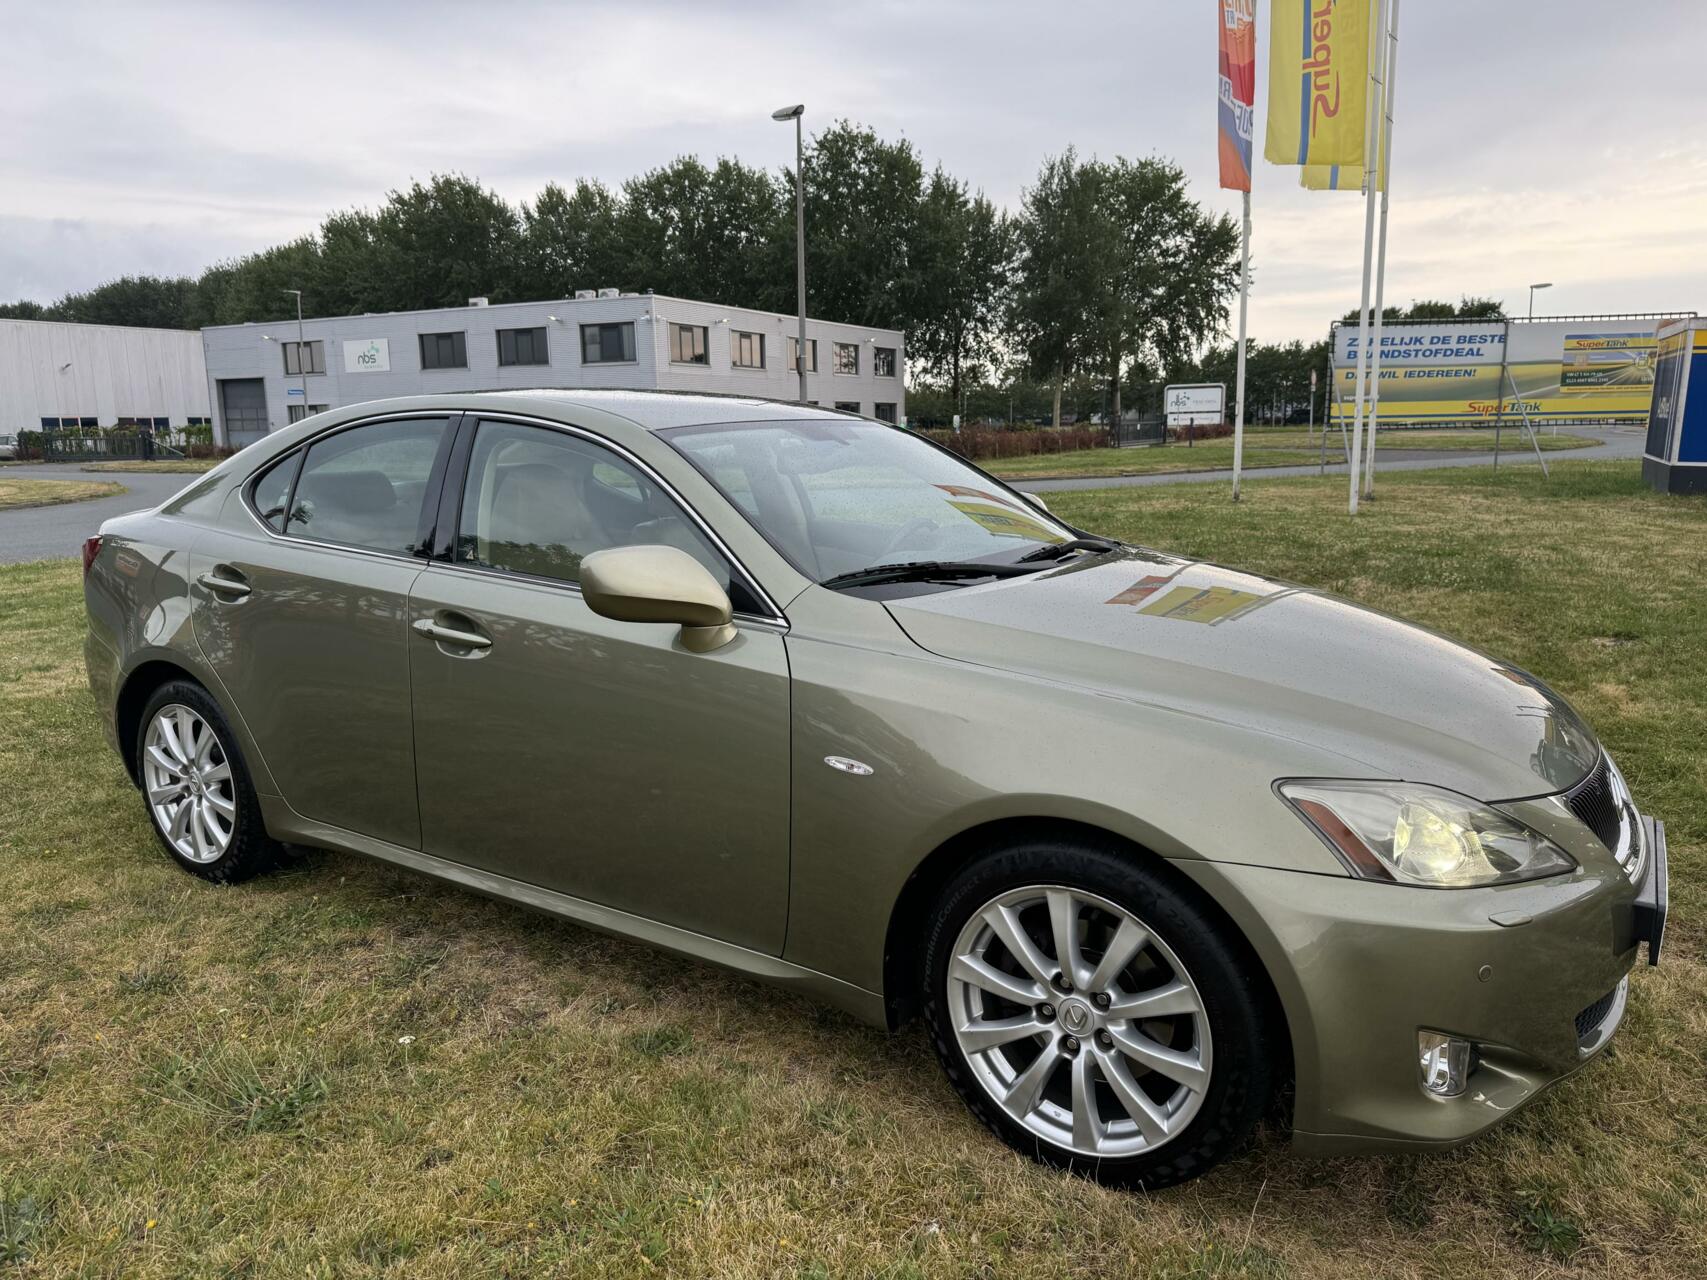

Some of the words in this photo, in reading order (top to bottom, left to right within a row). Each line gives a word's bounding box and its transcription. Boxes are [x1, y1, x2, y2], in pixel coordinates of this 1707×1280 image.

[1347, 336, 1425, 347] ZELIJK
[1429, 335, 1453, 345] DE
[1456, 334, 1507, 344] BESTE
[357, 352, 377, 365] nbs
[1347, 348, 1484, 359] BNDSTOFDEAL
[1345, 371, 1372, 380] DT
[1404, 368, 1476, 379] IEDEREEN!
